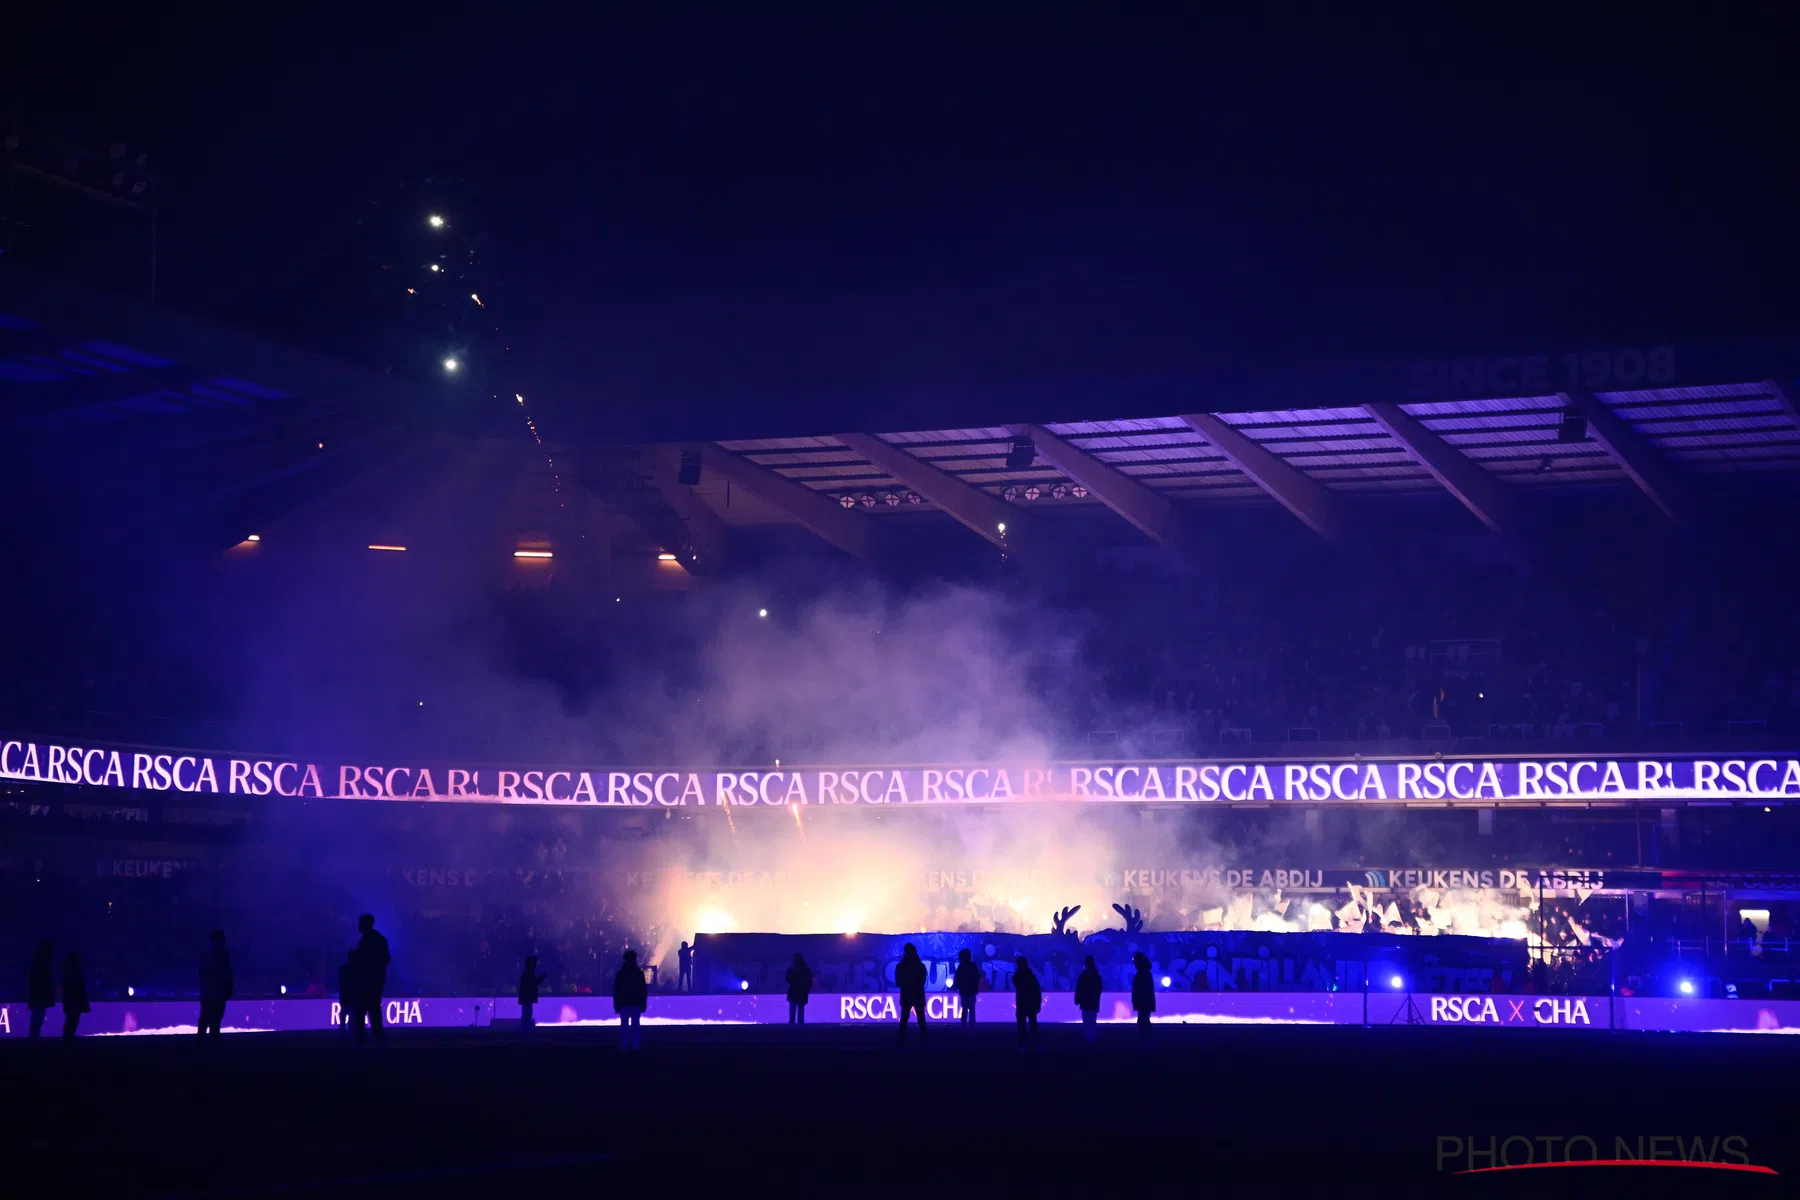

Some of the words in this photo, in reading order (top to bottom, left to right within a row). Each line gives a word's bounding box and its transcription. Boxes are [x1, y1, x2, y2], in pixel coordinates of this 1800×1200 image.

[1408, 354, 1549, 394] SINCE
[1562, 346, 1676, 388] 1908
[48, 745, 124, 787] RSCA
[133, 753, 219, 792] RSCA
[229, 760, 323, 797] RSCA
[339, 765, 432, 798] RSCA
[499, 771, 596, 801] RSCA
[608, 772, 705, 806] RSCA
[716, 772, 808, 806] RSCA
[818, 771, 908, 804] RSCA
[922, 769, 1013, 802] RSCA
[1070, 767, 1166, 800] RSCA
[1175, 766, 1274, 801] RSCA
[1285, 764, 1387, 800] RSCA
[1398, 763, 1501, 799] RSCA
[1519, 762, 1626, 798] RSCA
[1695, 760, 1800, 795] RSCA
[1227, 870, 1254, 888] DE
[1259, 870, 1324, 888] ABDIJ
[1389, 870, 1493, 888] KEUKENS
[386, 1001, 422, 1024] CHA
[841, 996, 898, 1019] RSCA
[926, 996, 963, 1019] CH
[1431, 997, 1499, 1023] RSCA
[1534, 999, 1590, 1024] CHA
